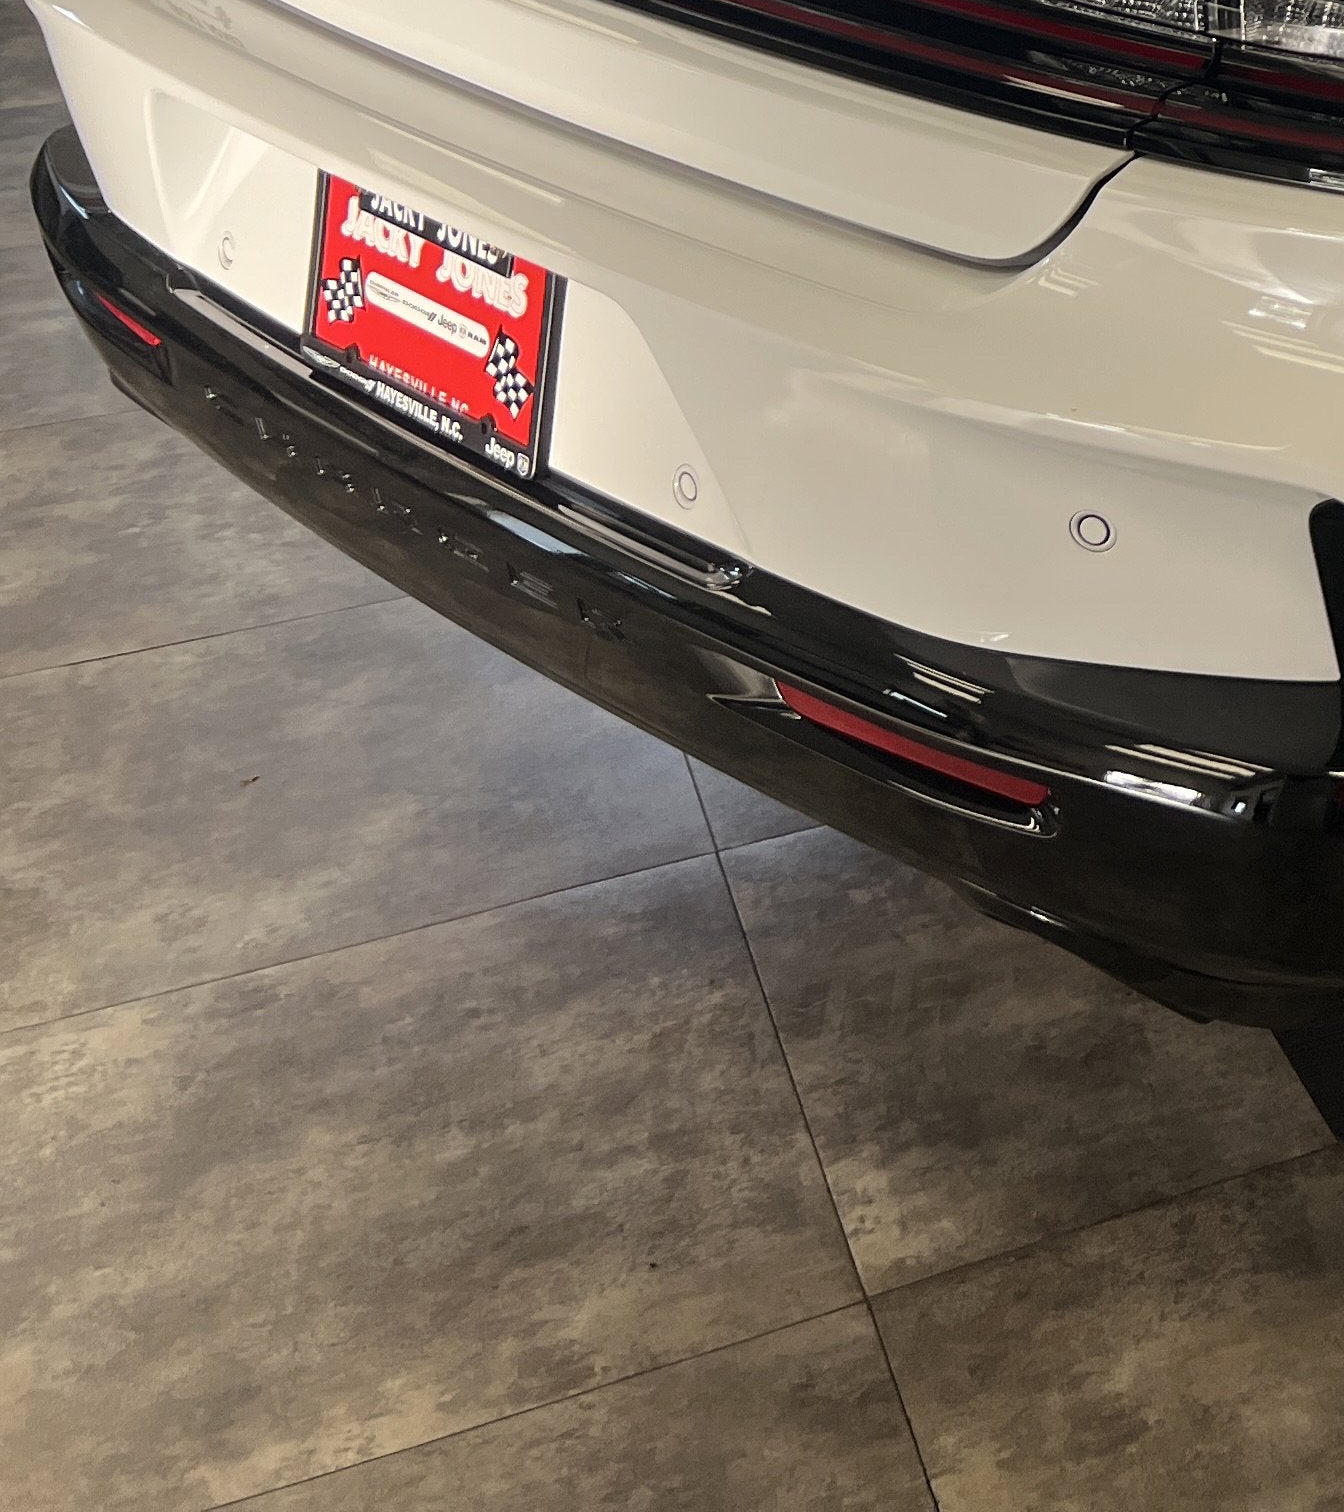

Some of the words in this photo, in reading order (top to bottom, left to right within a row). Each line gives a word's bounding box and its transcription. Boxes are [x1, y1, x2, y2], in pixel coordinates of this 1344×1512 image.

[371, 192, 426, 231] JACKY
[341, 195, 426, 269] JACKY
[435, 248, 530, 318] JONES
[437, 313, 459, 336] Jeep
[467, 331, 488, 347] RAM
[376, 380, 440, 432] HAYESVILLE,
[485, 436, 516, 472] Jeep
